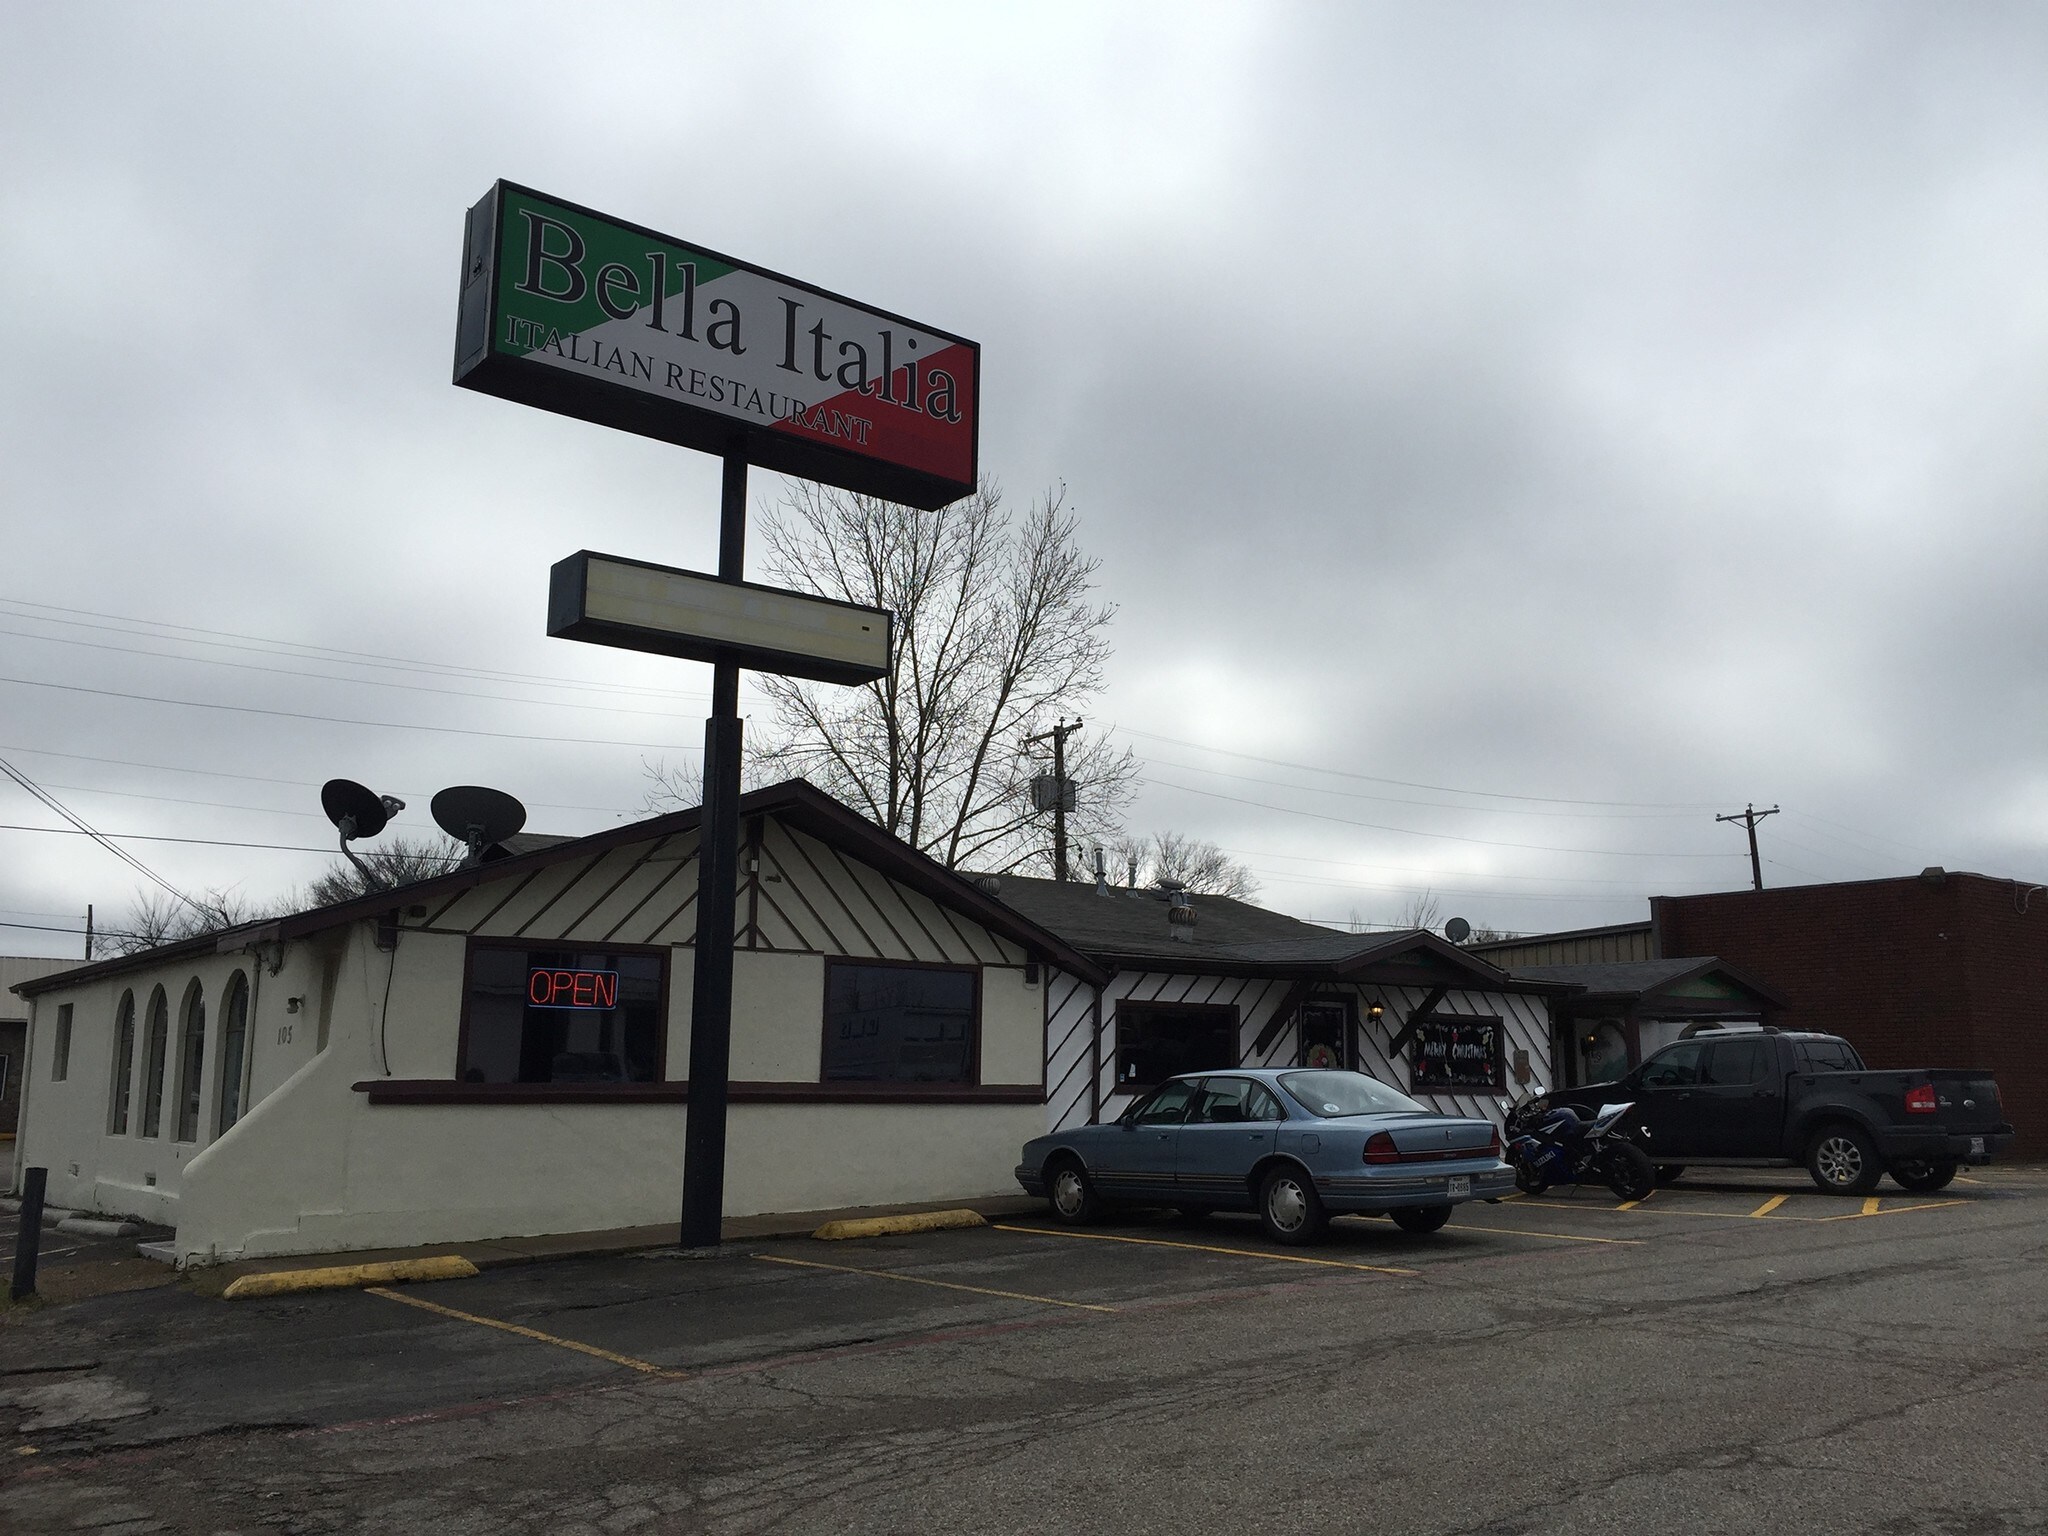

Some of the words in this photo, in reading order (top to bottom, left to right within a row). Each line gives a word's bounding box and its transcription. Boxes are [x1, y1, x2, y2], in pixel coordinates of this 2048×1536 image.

[514, 207, 747, 356] Bella
[776, 295, 962, 426] Italia
[505, 314, 655, 382] ITALIAN
[664, 360, 873, 446] RESTAURANT
[530, 970, 615, 1007] OPEN
[277, 1025, 293, 1045] 105
[1423, 1040, 1447, 1058] MERRY
[1533, 1150, 1556, 1168] SUZUKI
